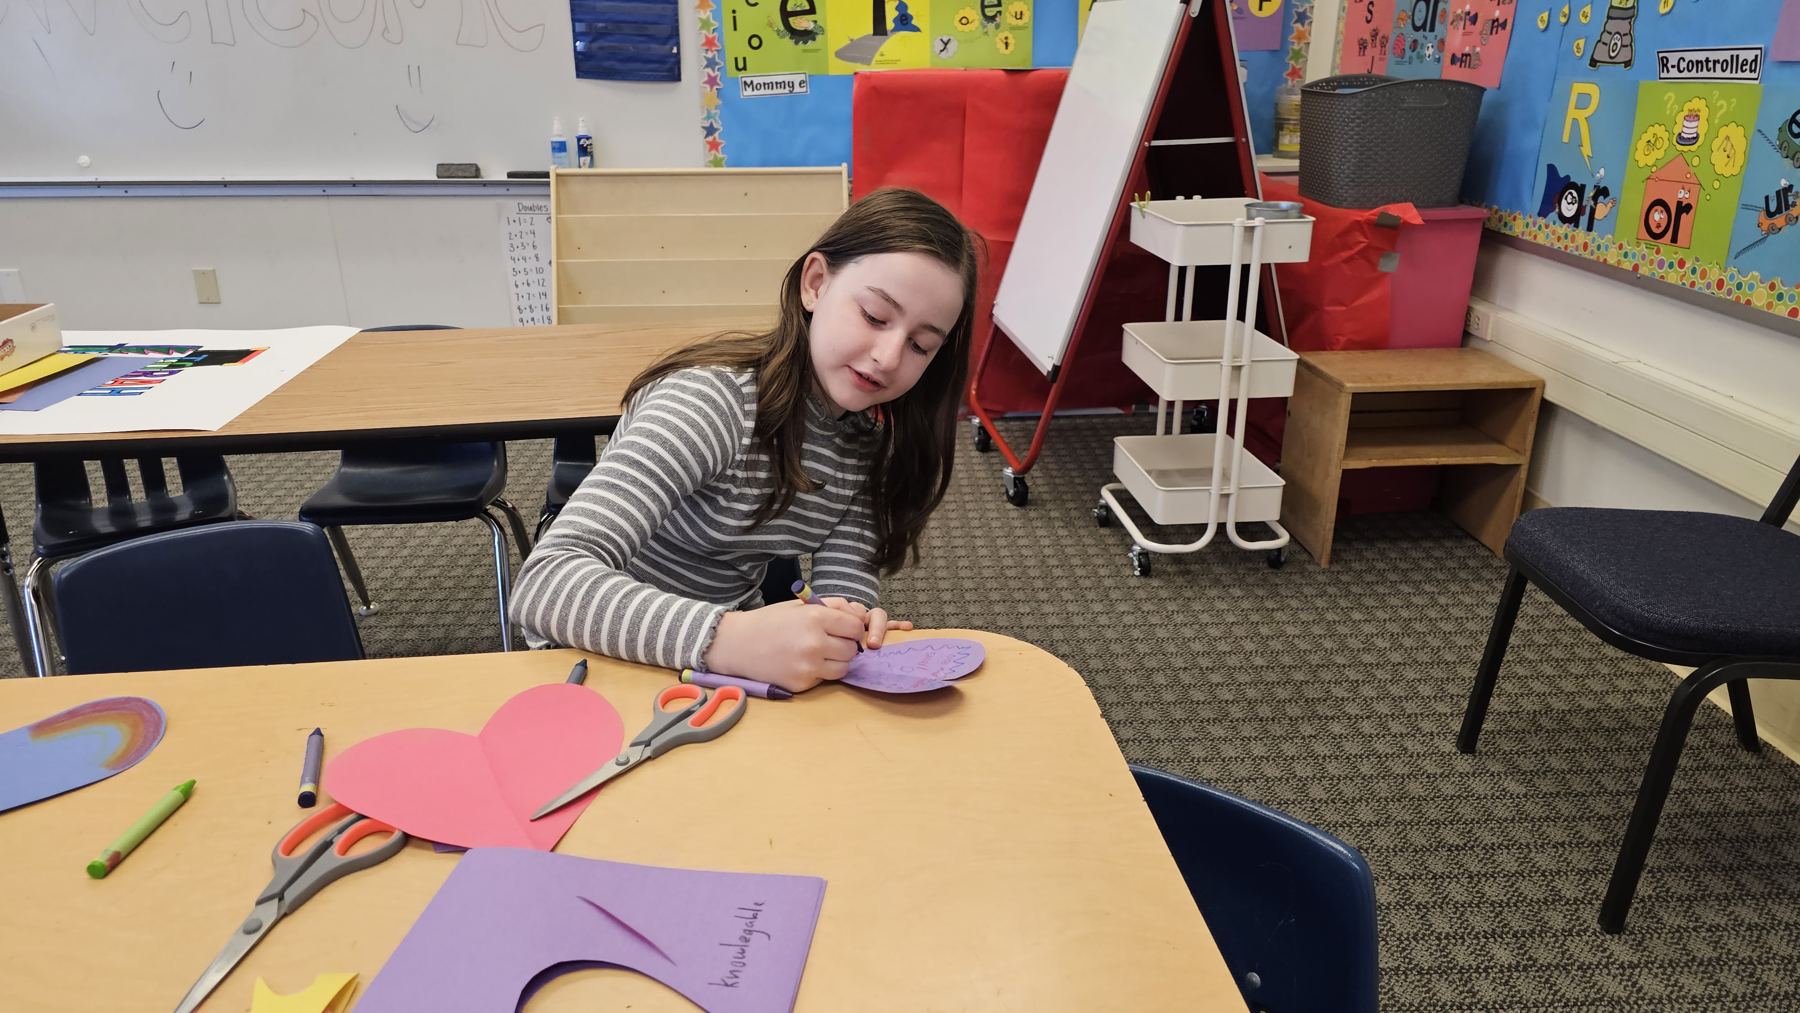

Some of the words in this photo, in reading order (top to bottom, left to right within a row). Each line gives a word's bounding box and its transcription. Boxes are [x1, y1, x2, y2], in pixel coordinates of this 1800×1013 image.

[732, 9, 738, 31] i
[748, 34, 763, 50] o
[734, 57, 747, 71] u
[1660, 53, 1759, 75] R-Controlled
[743, 80, 795, 94] Mommy
[799, 80, 806, 89] e
[517, 202, 549, 213] Doubles
[1557, 180, 1610, 232] ar
[1764, 184, 1794, 219] ur
[1643, 198, 1693, 244] or
